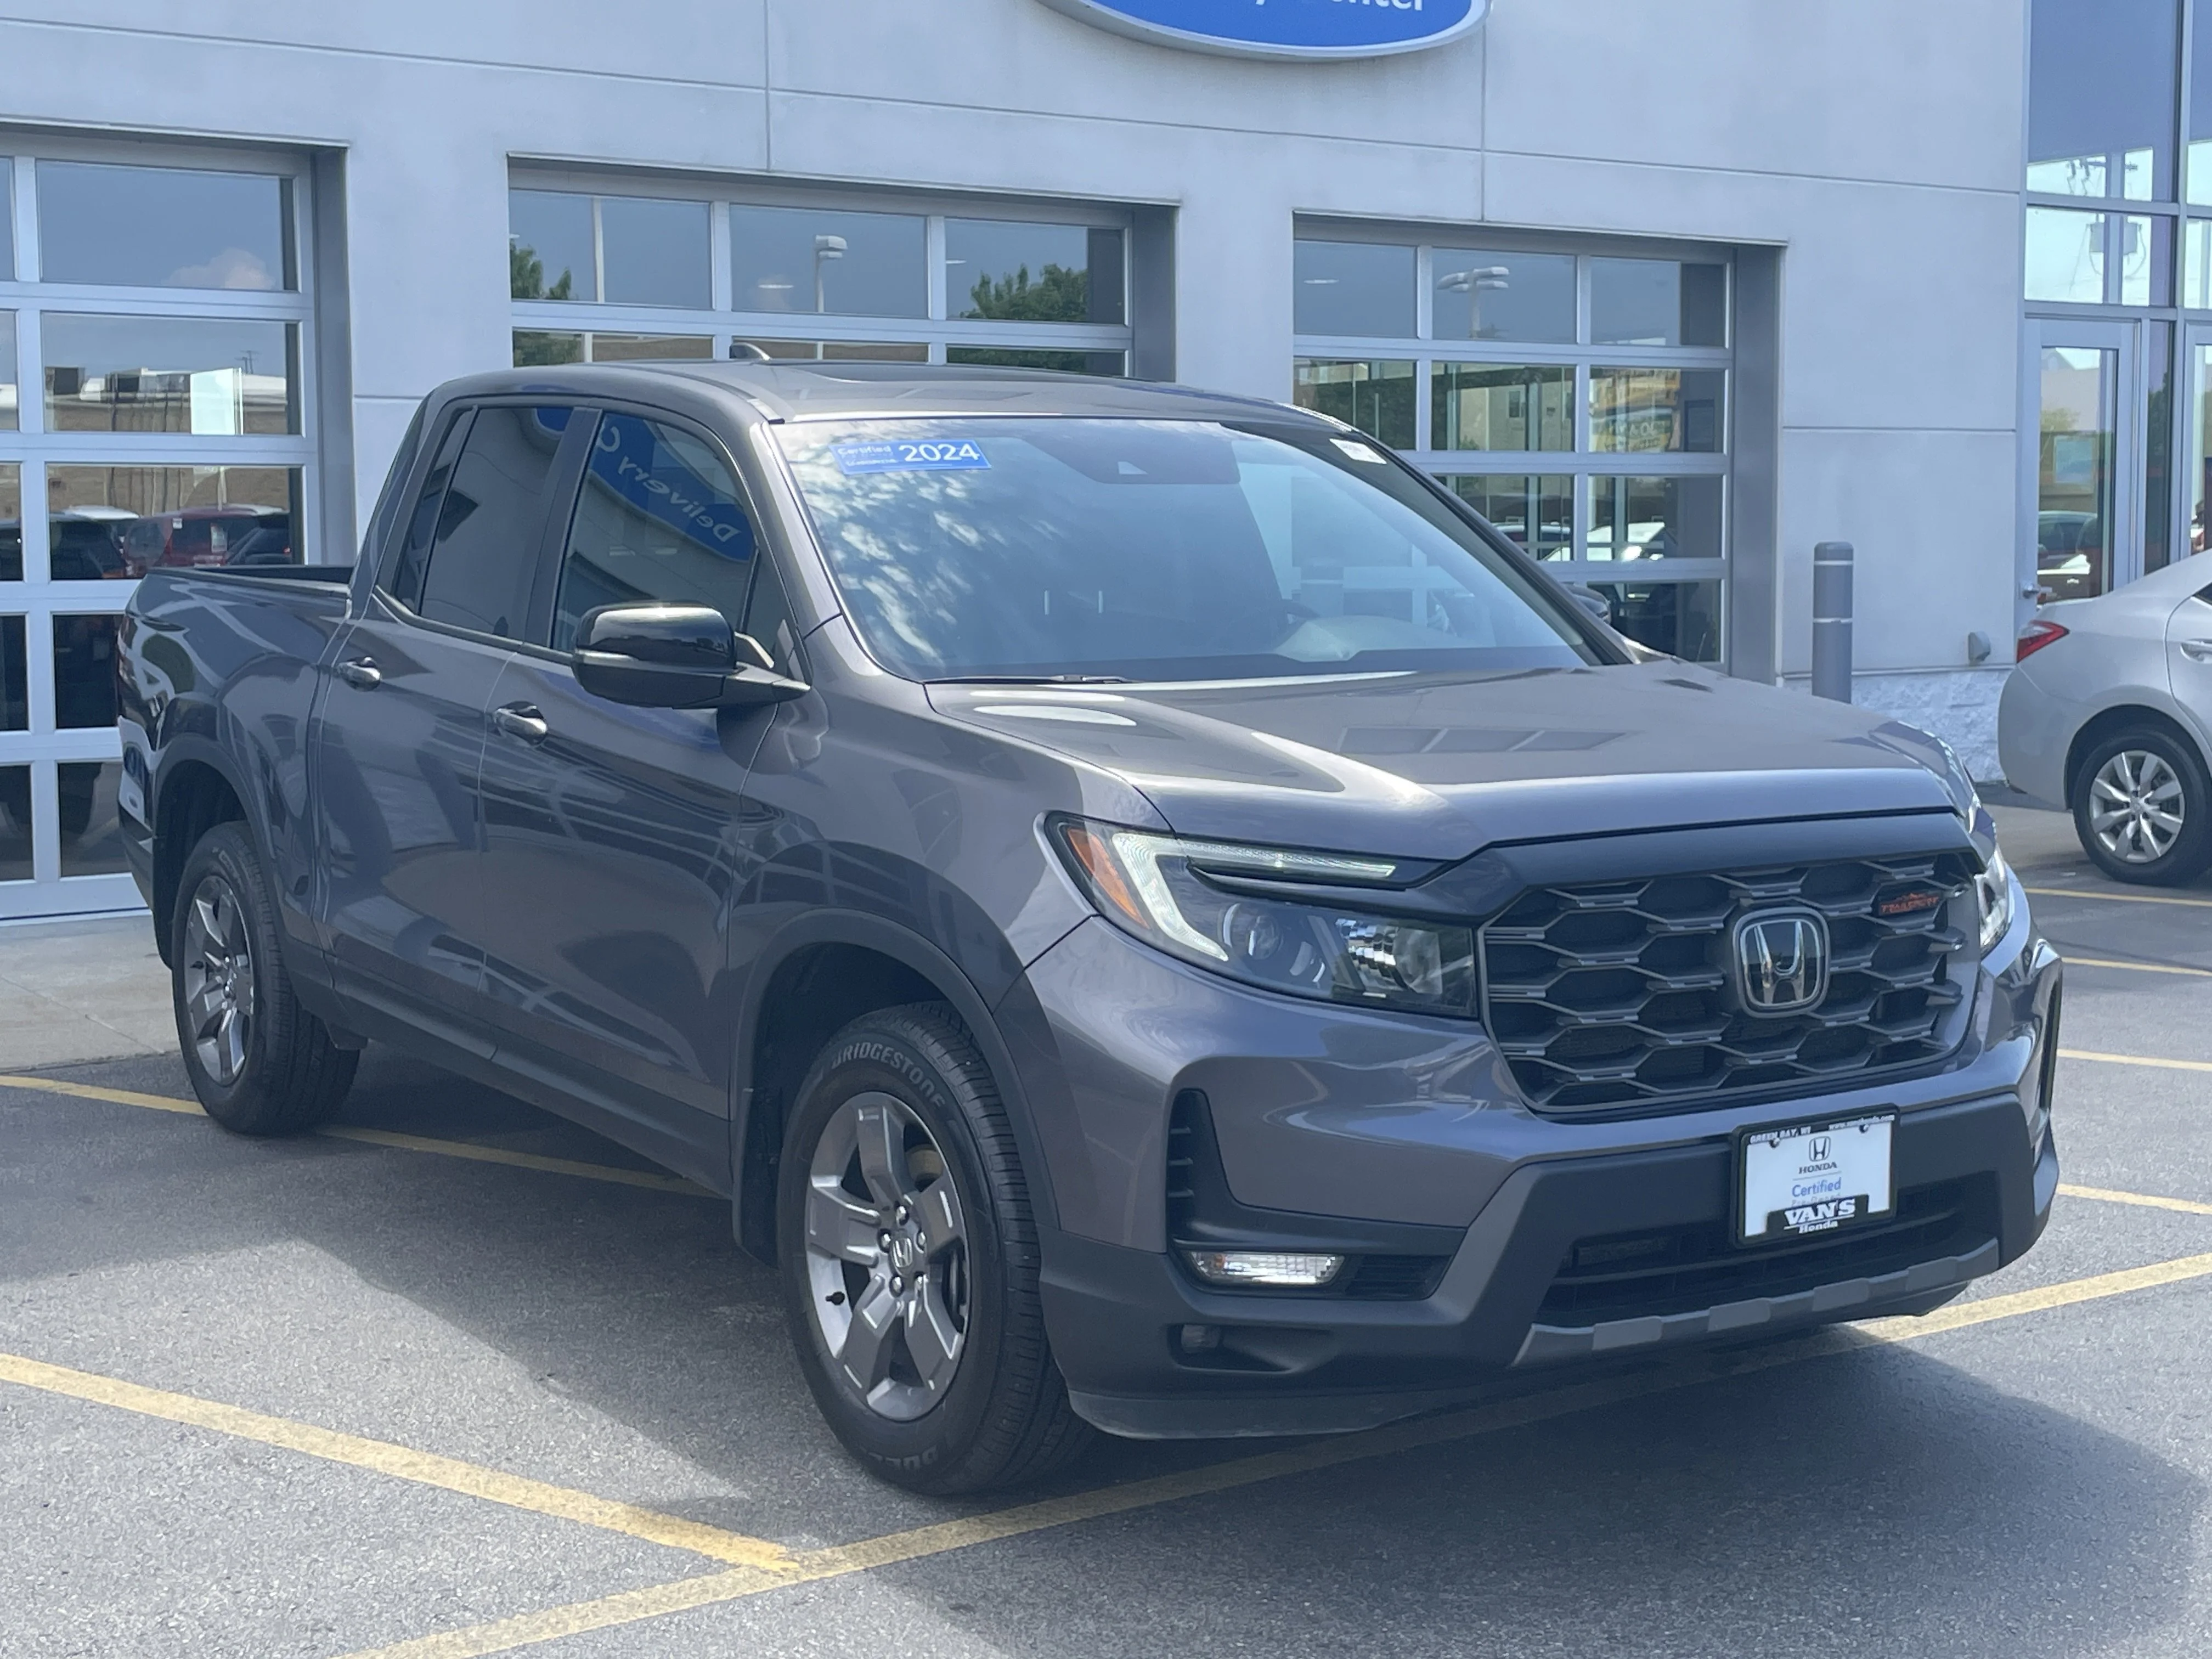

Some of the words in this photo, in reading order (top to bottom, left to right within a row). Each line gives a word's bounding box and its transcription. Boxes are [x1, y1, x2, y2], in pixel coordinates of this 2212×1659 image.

[899, 443, 981, 462] 2024
[832, 1042, 946, 1107] BRIDGESTONE
[1798, 1161, 1837, 1174] HONDA
[1792, 1177, 1842, 1197] Certified
[1798, 1221, 1838, 1234] Honda
